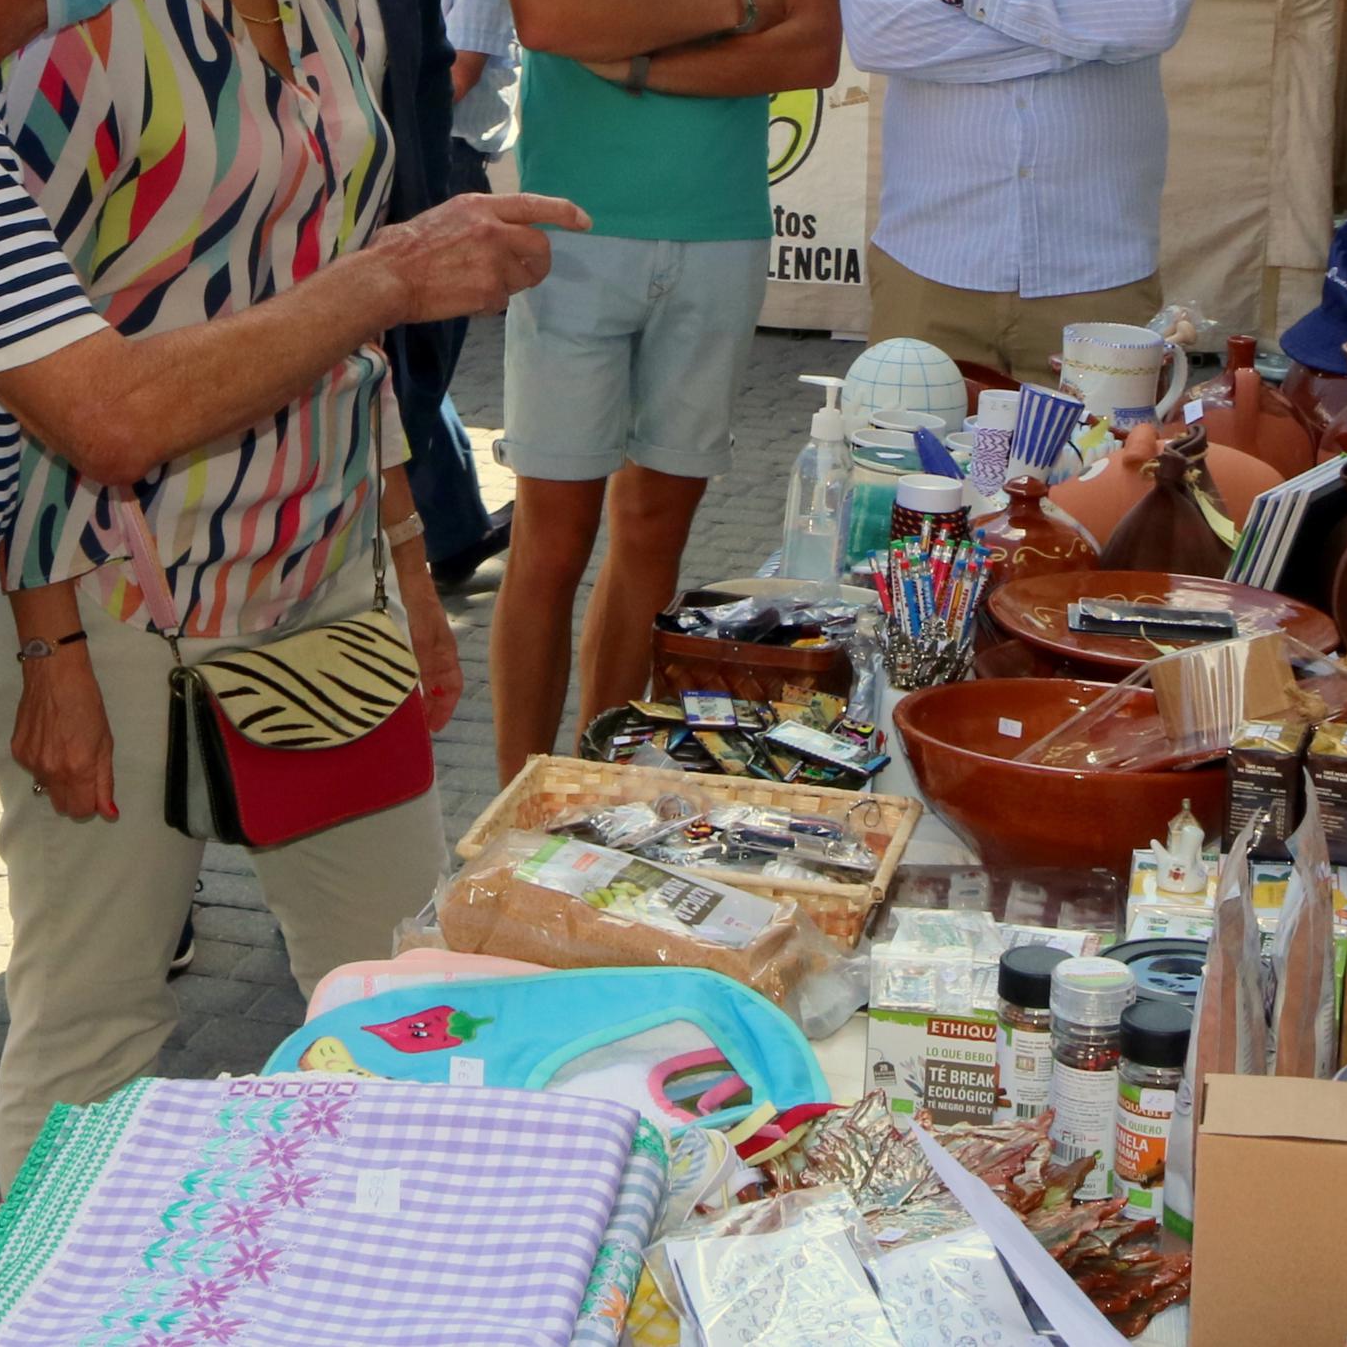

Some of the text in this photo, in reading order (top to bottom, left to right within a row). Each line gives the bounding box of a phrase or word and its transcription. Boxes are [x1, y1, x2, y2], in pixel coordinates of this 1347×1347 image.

[925, 1046, 994, 1064] LO QUE BEBO
[928, 1064, 995, 1089] TÉ BREAK
[926, 1099, 937, 1109] TÉ
[938, 1101, 964, 1113] NEGRO
[965, 1104, 977, 1114] DE
[1128, 1119, 1163, 1135] QUIERO
